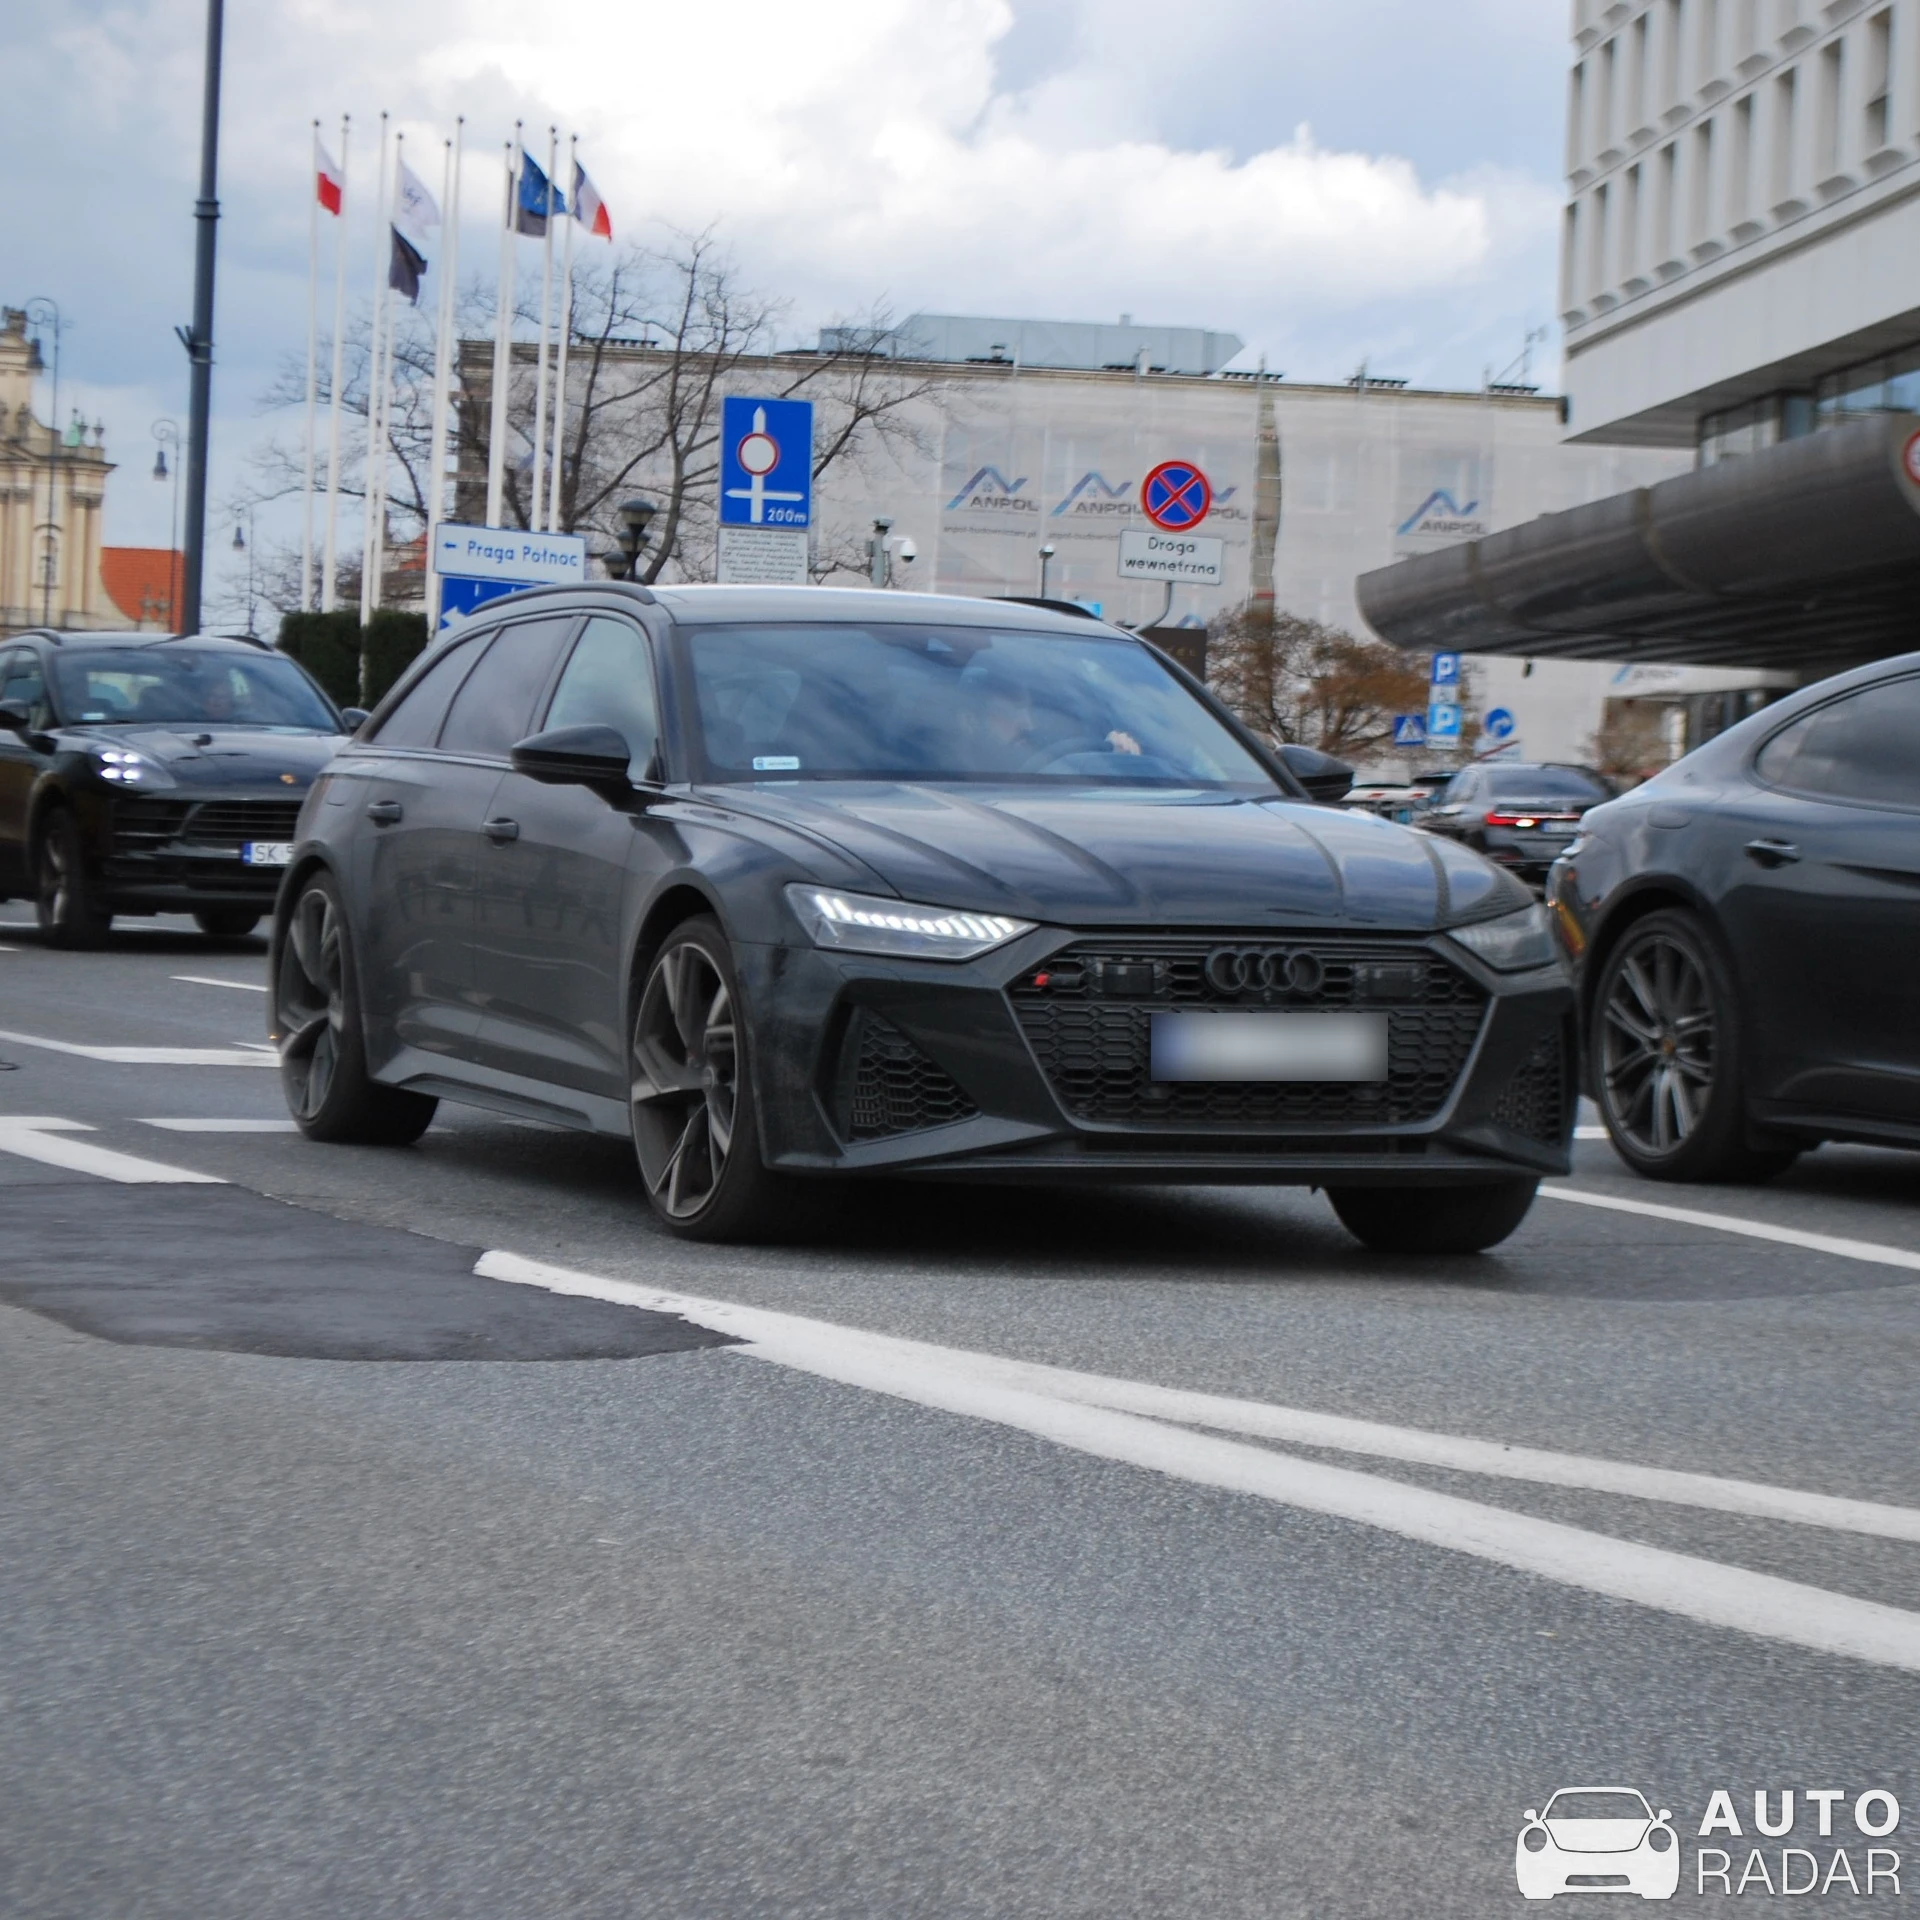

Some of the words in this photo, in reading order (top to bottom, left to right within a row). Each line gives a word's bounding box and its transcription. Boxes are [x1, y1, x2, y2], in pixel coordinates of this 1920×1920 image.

[969, 496, 1038, 512] ANPOL
[767, 507, 807, 523] 200m
[467, 540, 515, 564] Praga
[1148, 536, 1195, 556] Droga
[1437, 656, 1454, 681] P
[1434, 706, 1456, 732] P
[255, 844, 279, 862] SK
